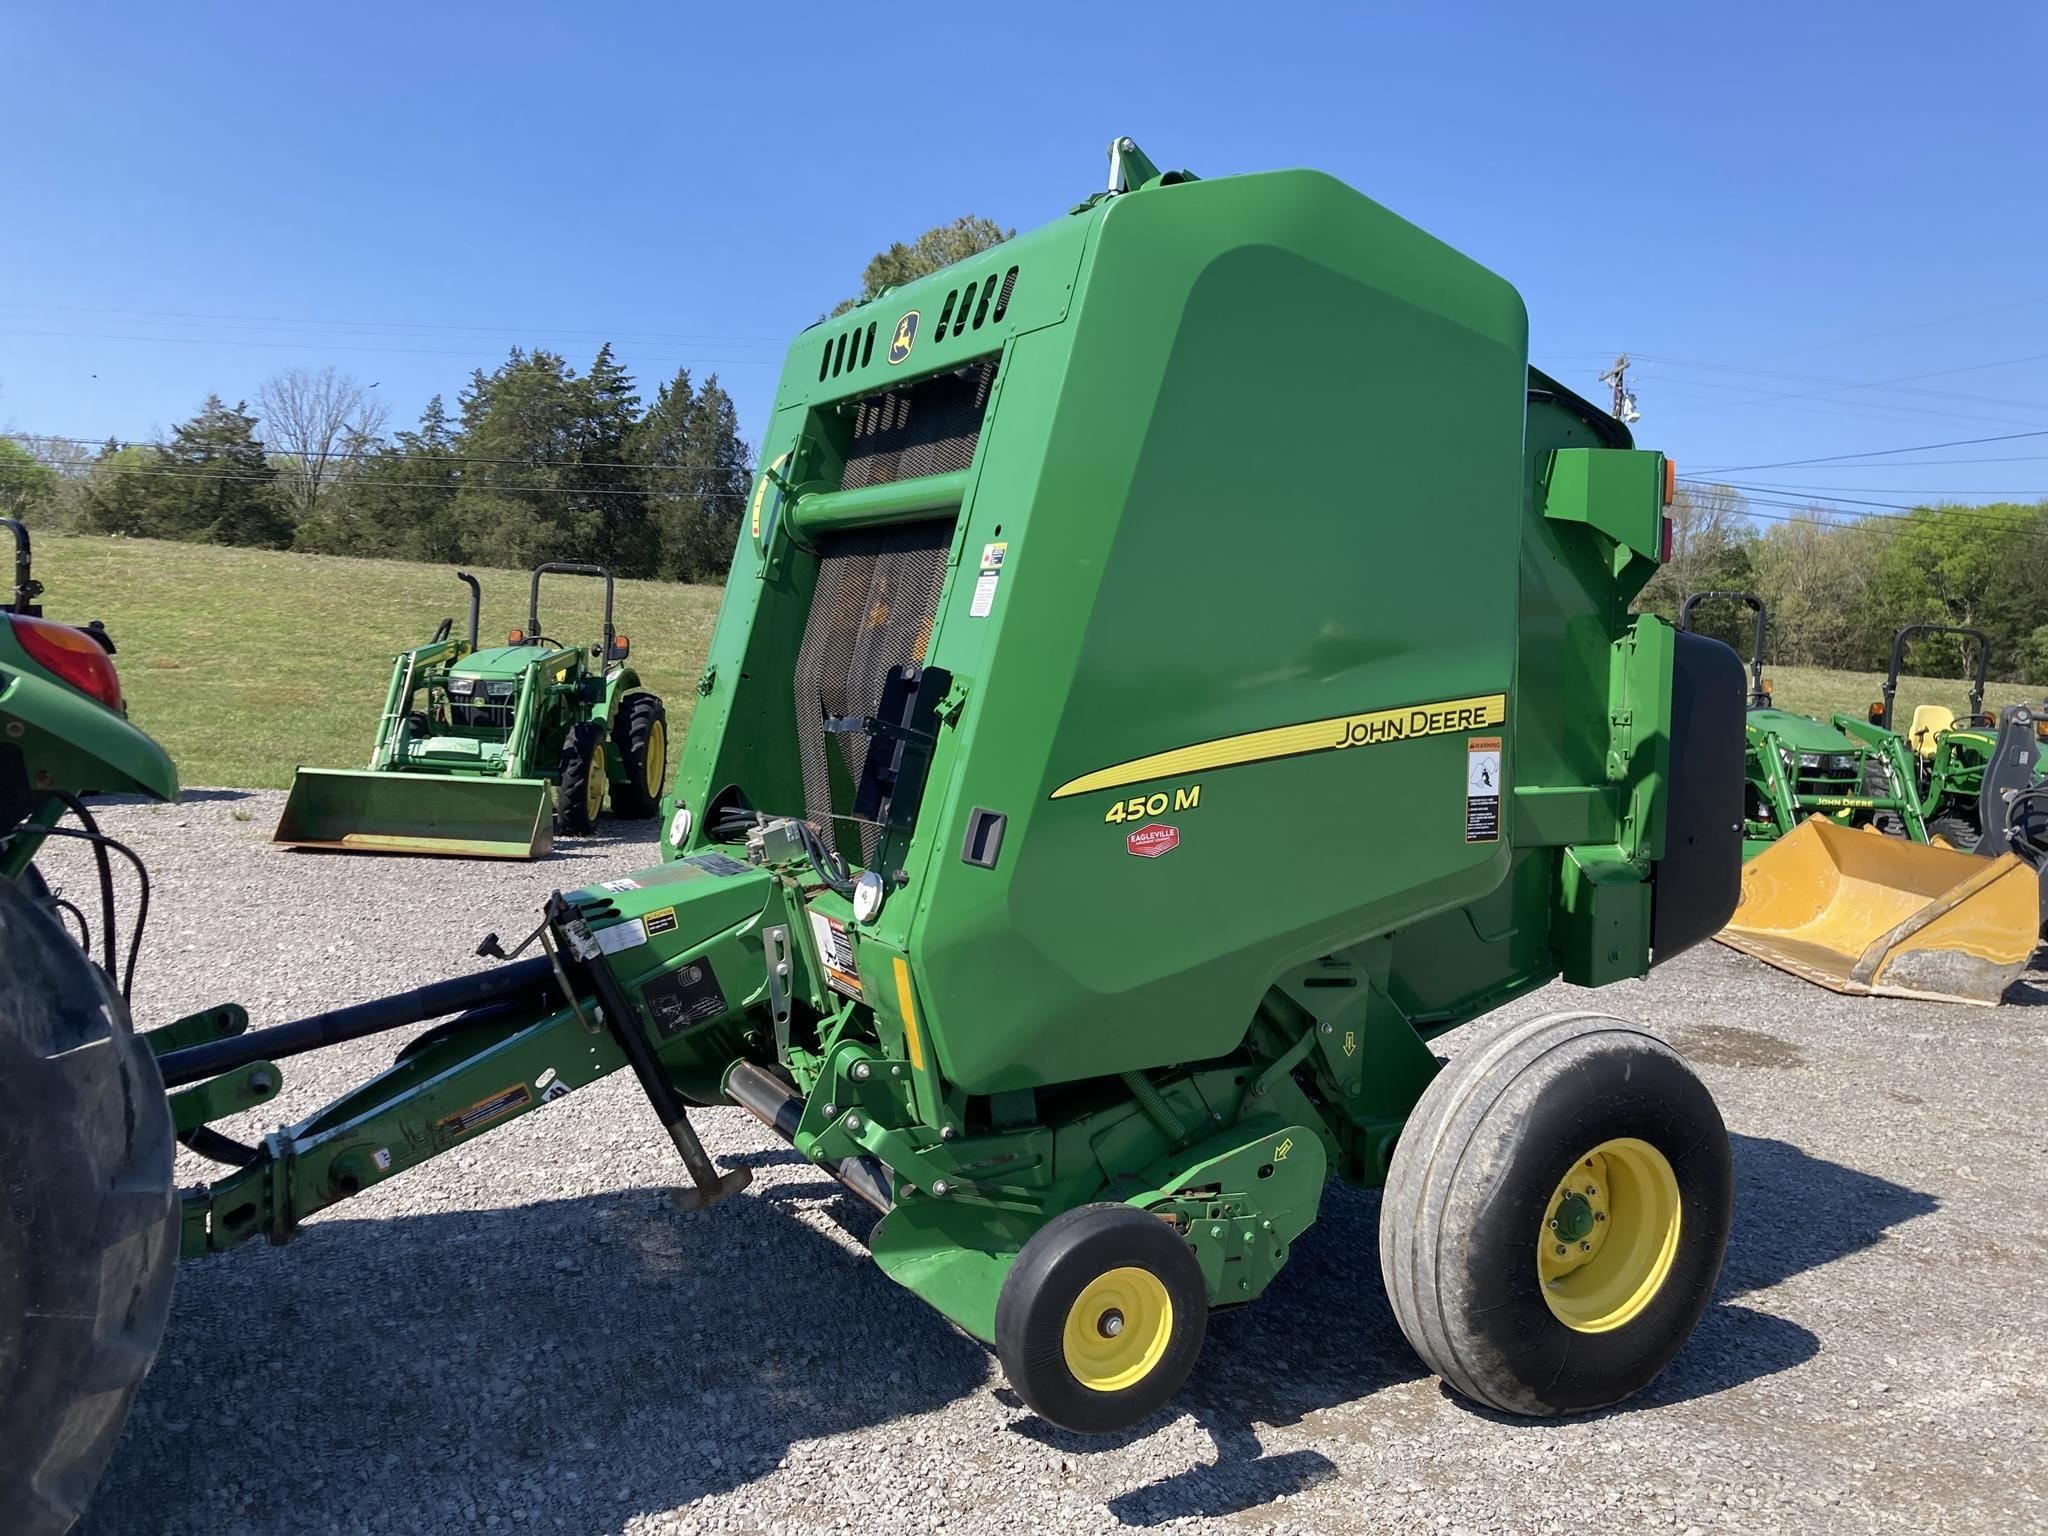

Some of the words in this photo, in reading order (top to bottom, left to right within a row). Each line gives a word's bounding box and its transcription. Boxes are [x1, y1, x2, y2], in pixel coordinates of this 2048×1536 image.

[1335, 717, 1404, 746] JOHN
[1410, 706, 1487, 734] DEERE
[1105, 792, 1169, 824] 450
[1174, 784, 1201, 812] M
[1816, 797, 1841, 806] JOHN
[1842, 798, 1873, 807] DEERE
[1130, 828, 1176, 842] EAGLEVILLE
